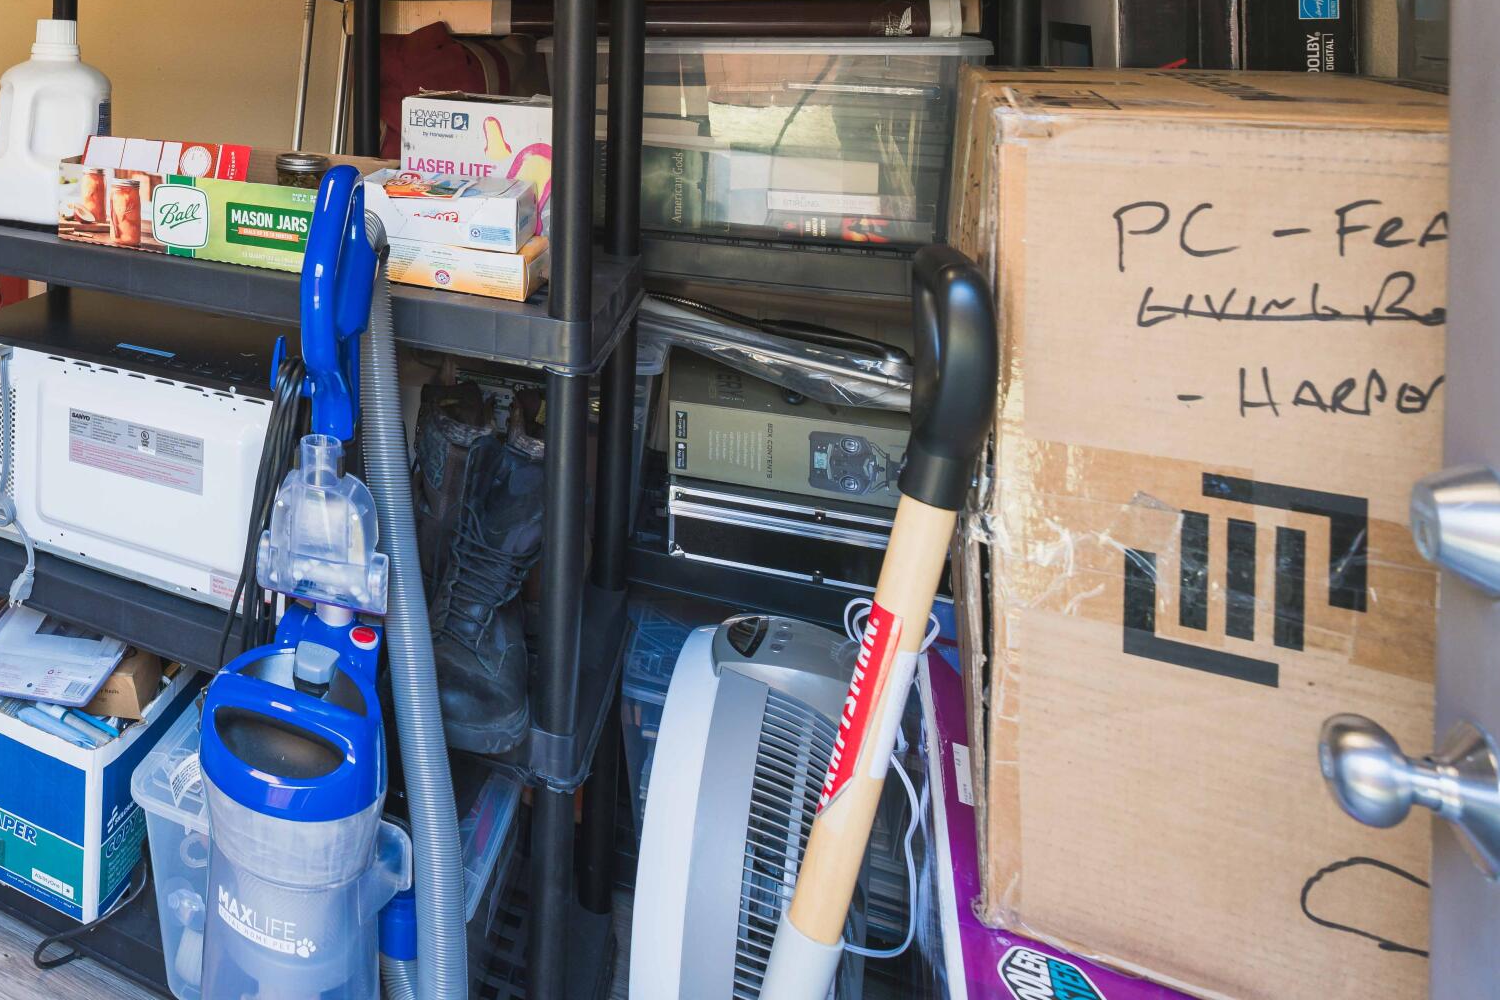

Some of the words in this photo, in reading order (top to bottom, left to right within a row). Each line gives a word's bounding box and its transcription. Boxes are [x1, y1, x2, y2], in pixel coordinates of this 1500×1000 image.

[1326, 39, 1334, 70] DIGITAL
[409, 108, 450, 119] HOWARD
[409, 117, 450, 129] LEIGHT
[430, 131, 454, 139] Honeywell
[408, 156, 454, 175] LASER
[460, 162, 493, 177] LITE
[673, 152, 684, 175] Gods
[671, 177, 683, 224] American
[160, 202, 202, 229] Ball
[231, 209, 273, 228] MASON
[276, 216, 308, 233] JARS
[1113, 201, 1241, 272] PC
[72, 412, 90, 421] SANYO
[35, 872, 60, 889] AbilityOne
[244, 928, 268, 945] HOME
[272, 941, 291, 951] PET
[1005, 949, 1054, 1000] OOLER
